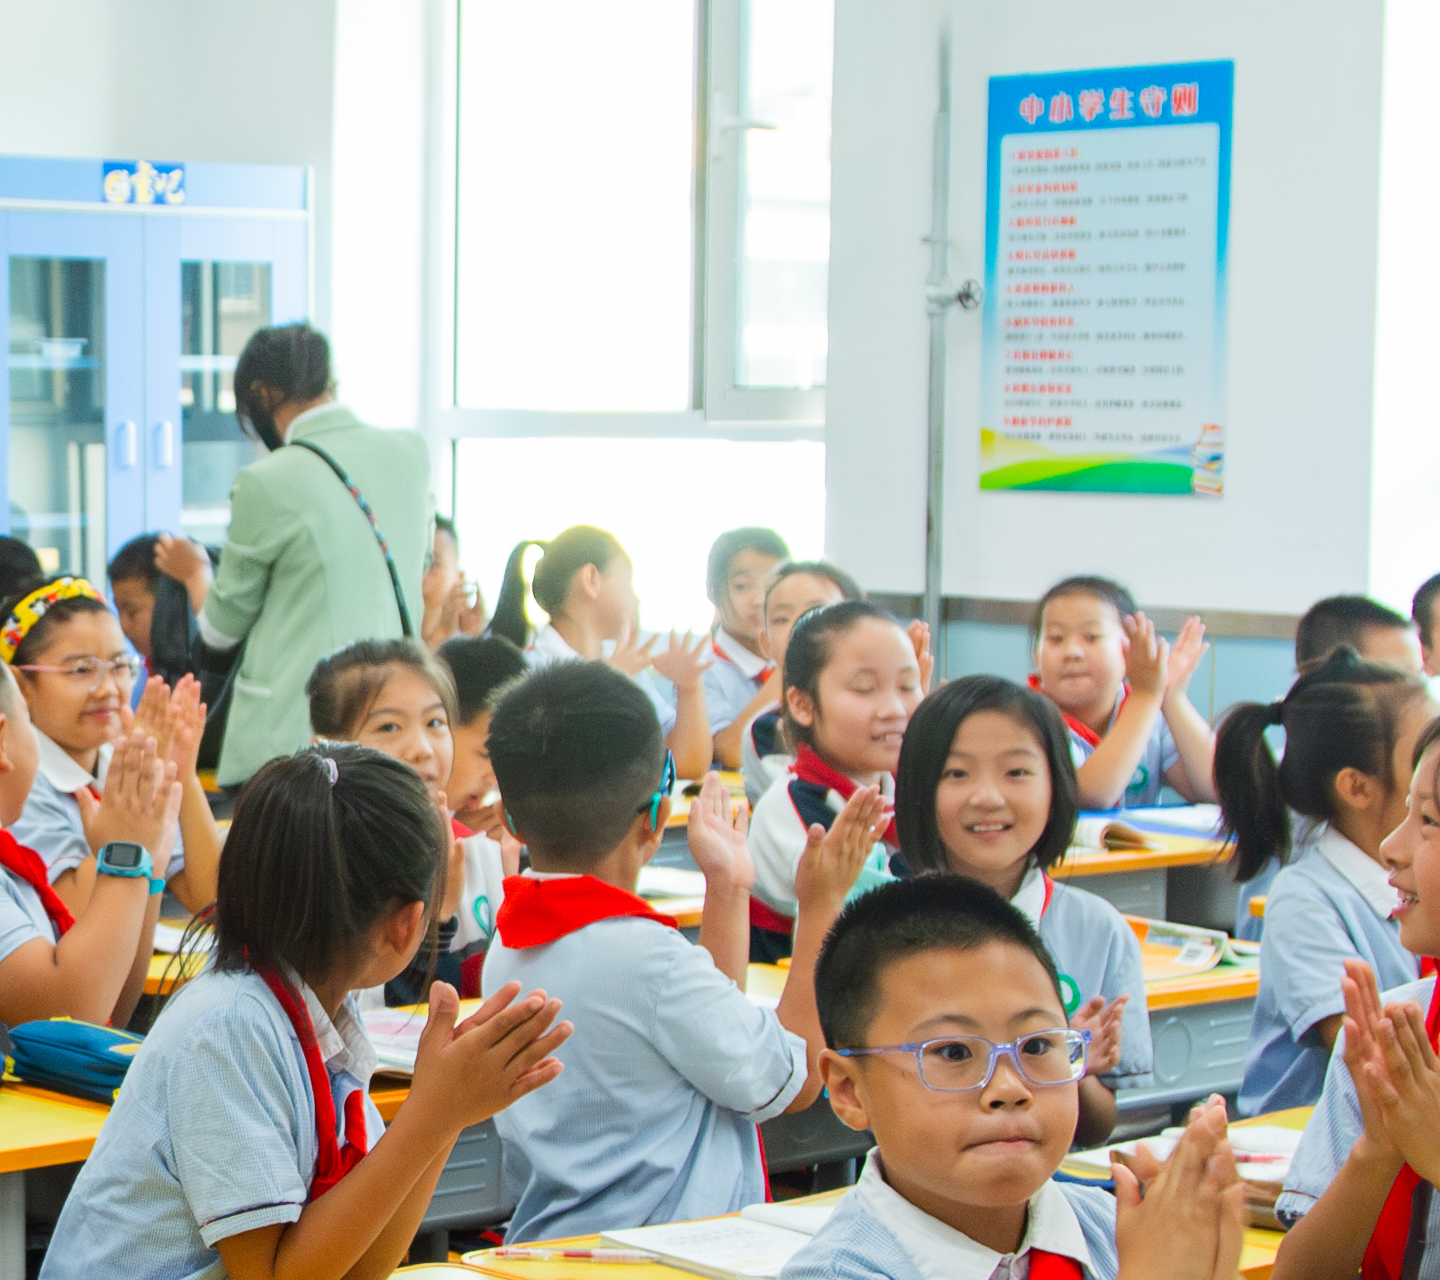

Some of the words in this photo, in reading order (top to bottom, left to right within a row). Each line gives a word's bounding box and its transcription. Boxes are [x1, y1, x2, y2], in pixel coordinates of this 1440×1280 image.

[1019, 82, 1199, 125] 中小学生守则
